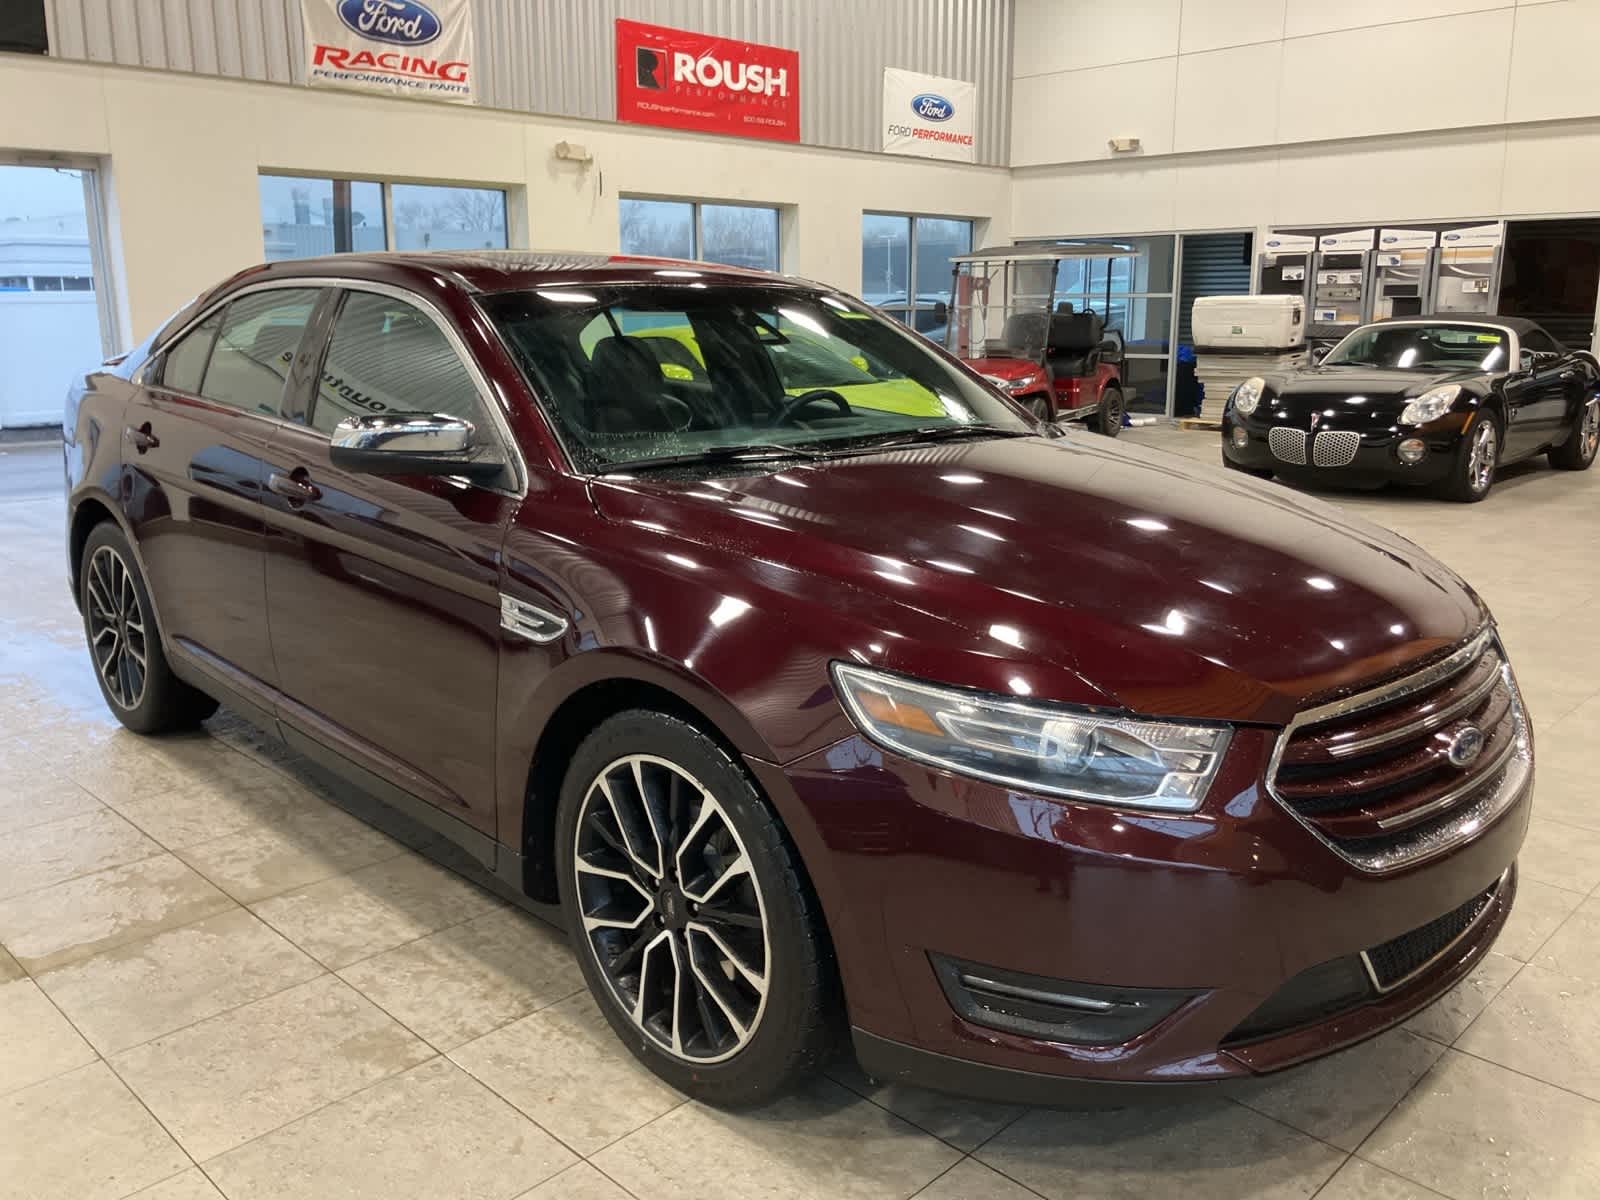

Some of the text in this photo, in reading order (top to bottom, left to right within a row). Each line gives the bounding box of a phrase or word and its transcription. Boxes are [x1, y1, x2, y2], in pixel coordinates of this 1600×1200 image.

[358, 0, 422, 38] Ford
[313, 44, 469, 82] RACING
[673, 51, 787, 97] ROUSH
[313, 69, 469, 94] PERFORMANCE PARTS
[675, 85, 788, 108] PERFORMANCE
[919, 97, 946, 117] Ford
[888, 124, 973, 146] FORD PERFORMANCE
